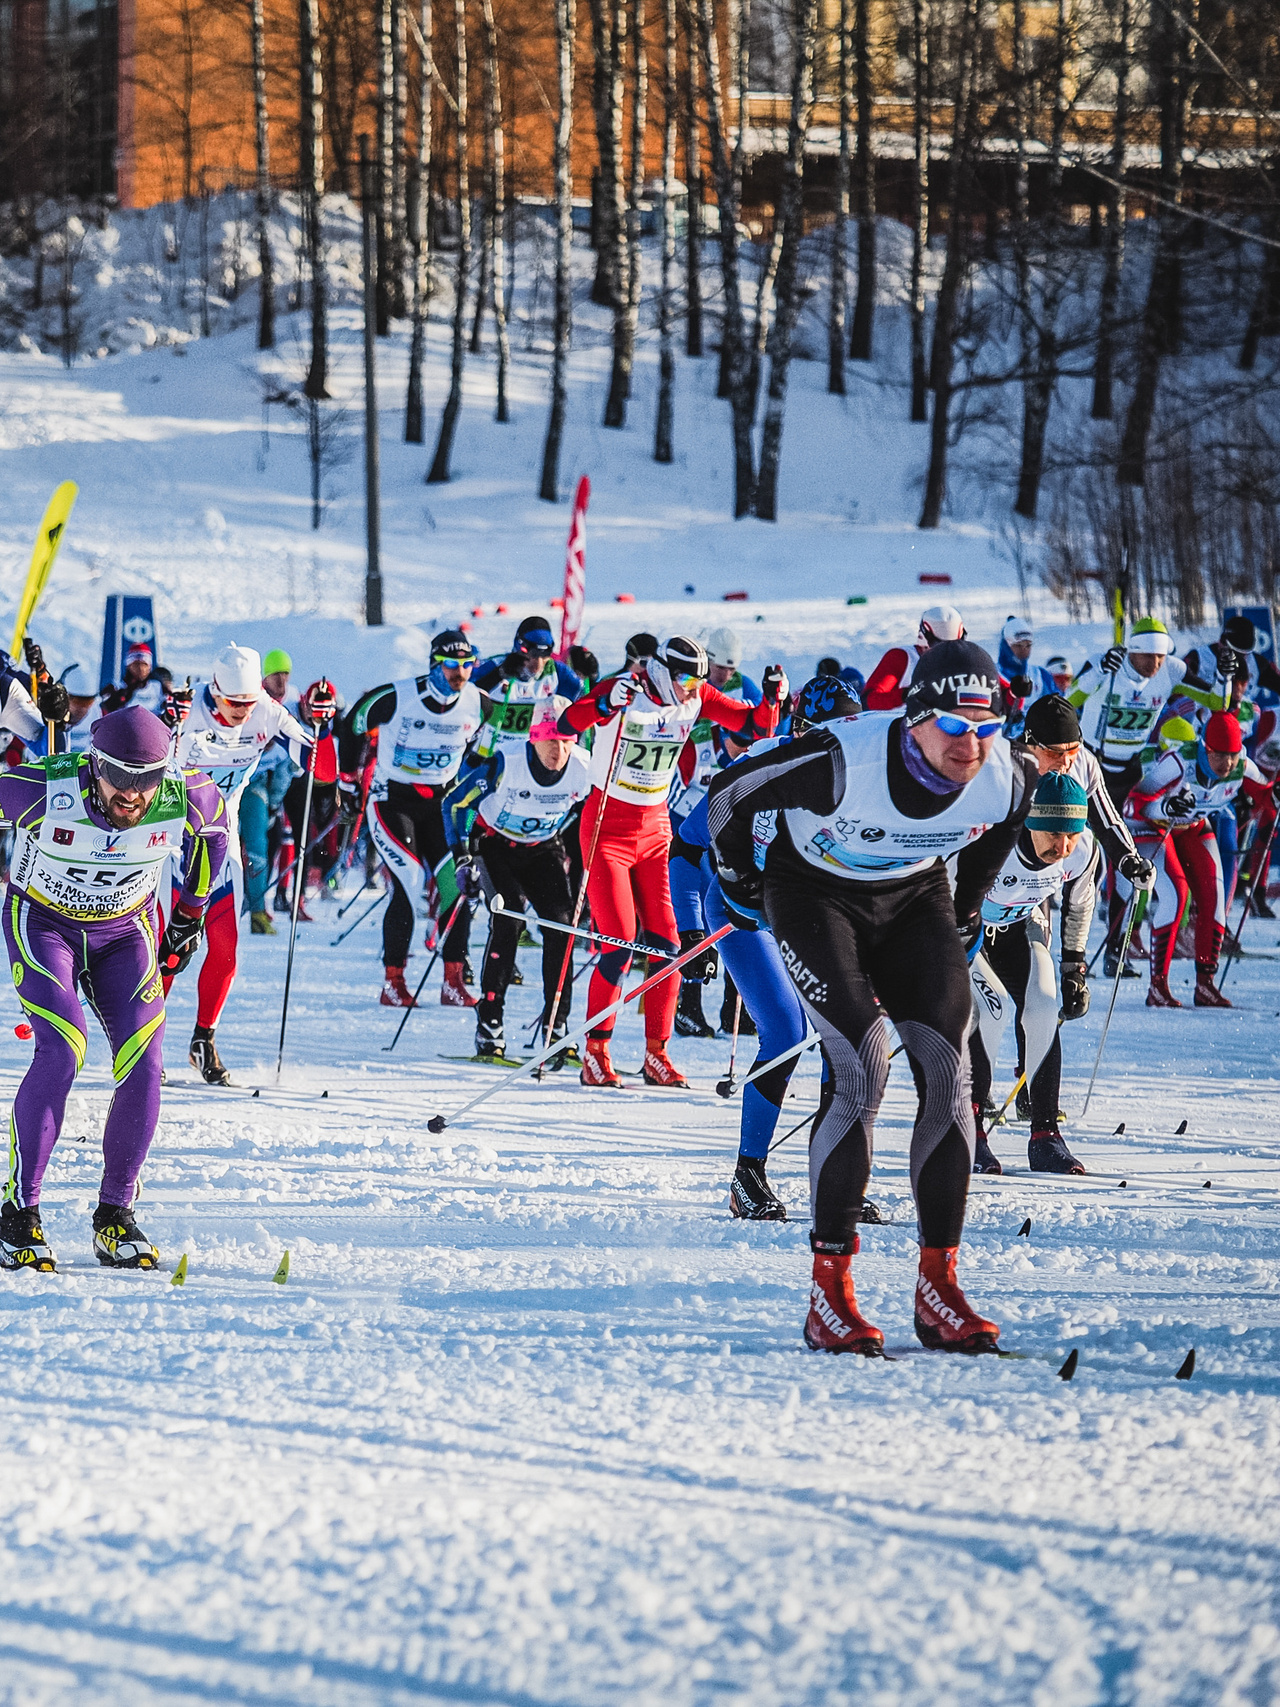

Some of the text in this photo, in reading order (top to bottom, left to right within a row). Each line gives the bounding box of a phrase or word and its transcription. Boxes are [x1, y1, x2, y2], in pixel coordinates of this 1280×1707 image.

[1108, 710, 1152, 729] 222
[627, 744, 679, 771] 211
[911, 831, 965, 839] МОСКОВСКИЙ
[58, 900, 124, 911] МАРАФОН
[597, 934, 660, 955] MADSHUS
[779, 940, 819, 990] CRAFT
[918, 1273, 965, 1331] alpina
